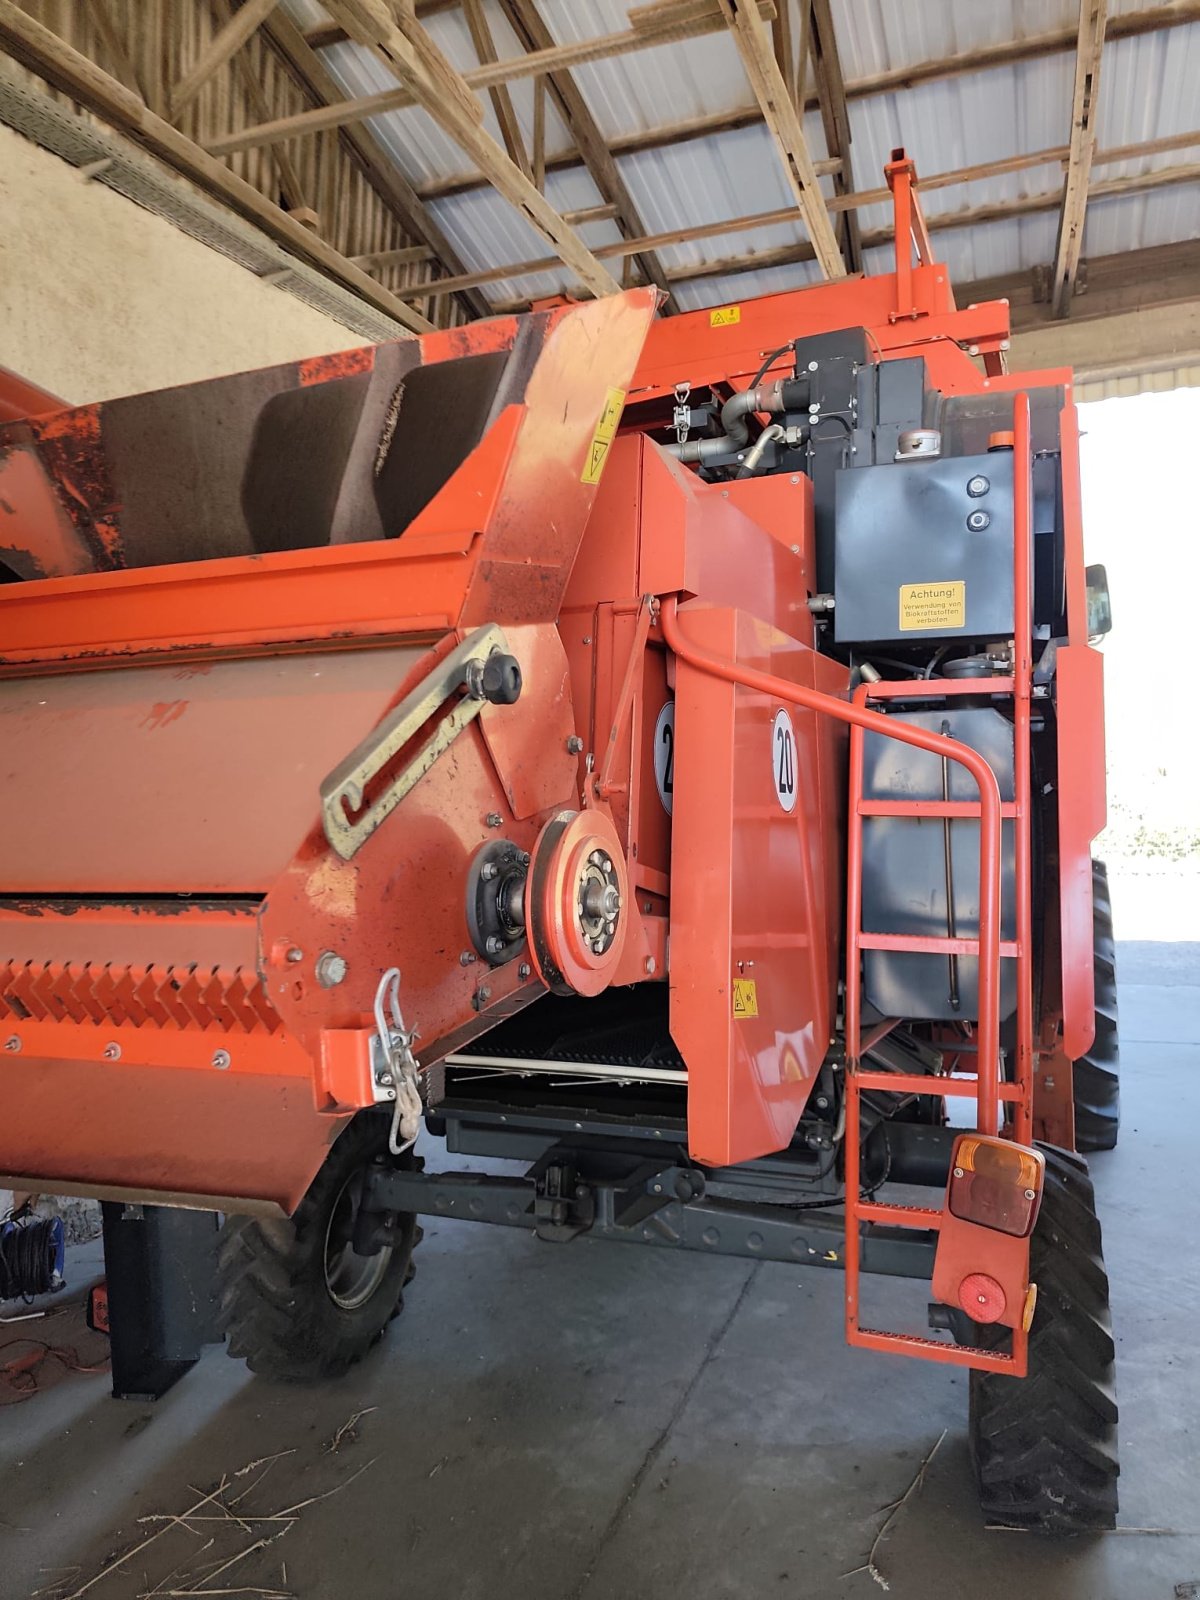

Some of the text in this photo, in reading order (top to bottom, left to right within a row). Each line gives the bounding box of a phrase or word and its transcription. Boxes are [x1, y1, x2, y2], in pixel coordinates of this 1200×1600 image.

[910, 587, 955, 599] Achtung!
[903, 602, 946, 610] Verwendung
[905, 609, 959, 617] Biokraftstoffen
[662, 723, 674, 793] 2
[777, 726, 793, 794] 20
